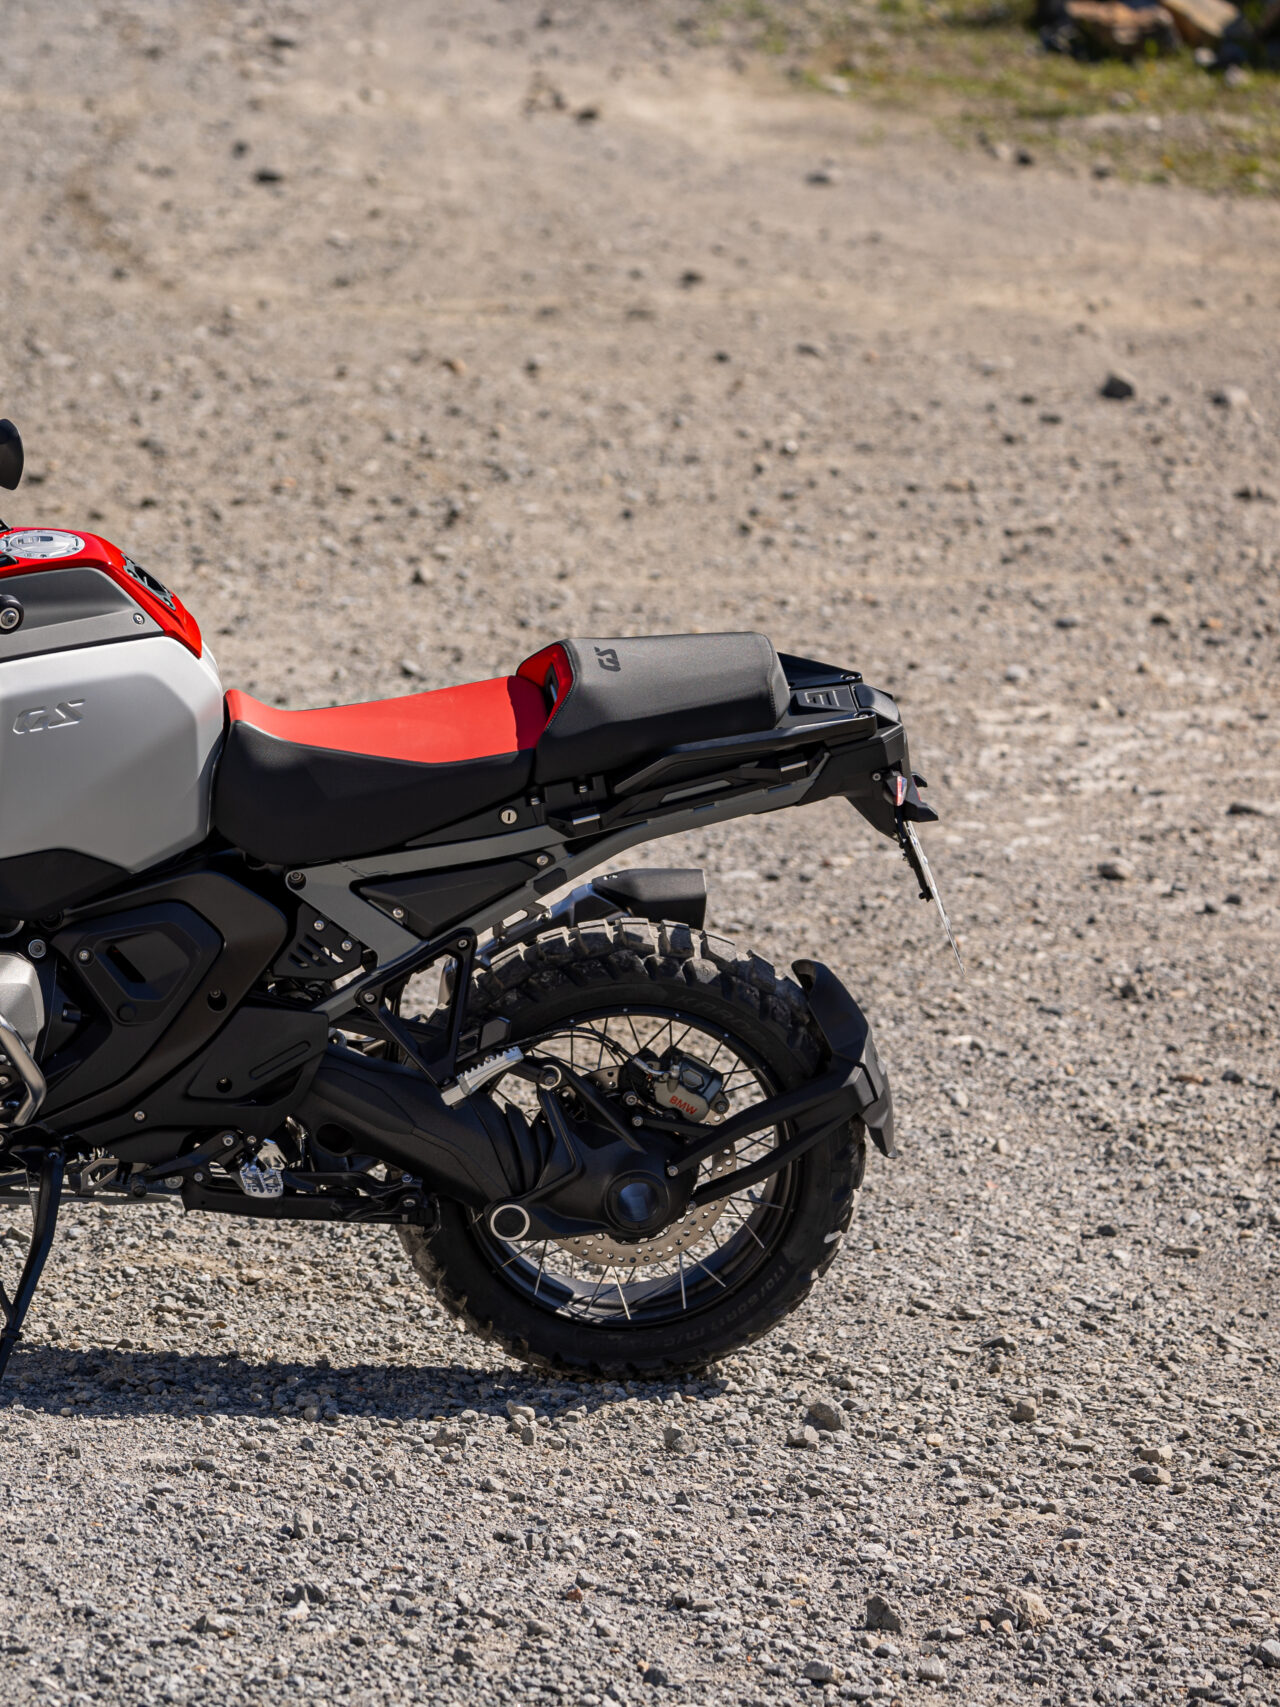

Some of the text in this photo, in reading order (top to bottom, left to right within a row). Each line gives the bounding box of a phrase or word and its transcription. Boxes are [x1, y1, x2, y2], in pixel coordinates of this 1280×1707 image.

[594, 646, 621, 672] GS
[13, 699, 85, 735] GS
[669, 1095, 698, 1115] BMW
